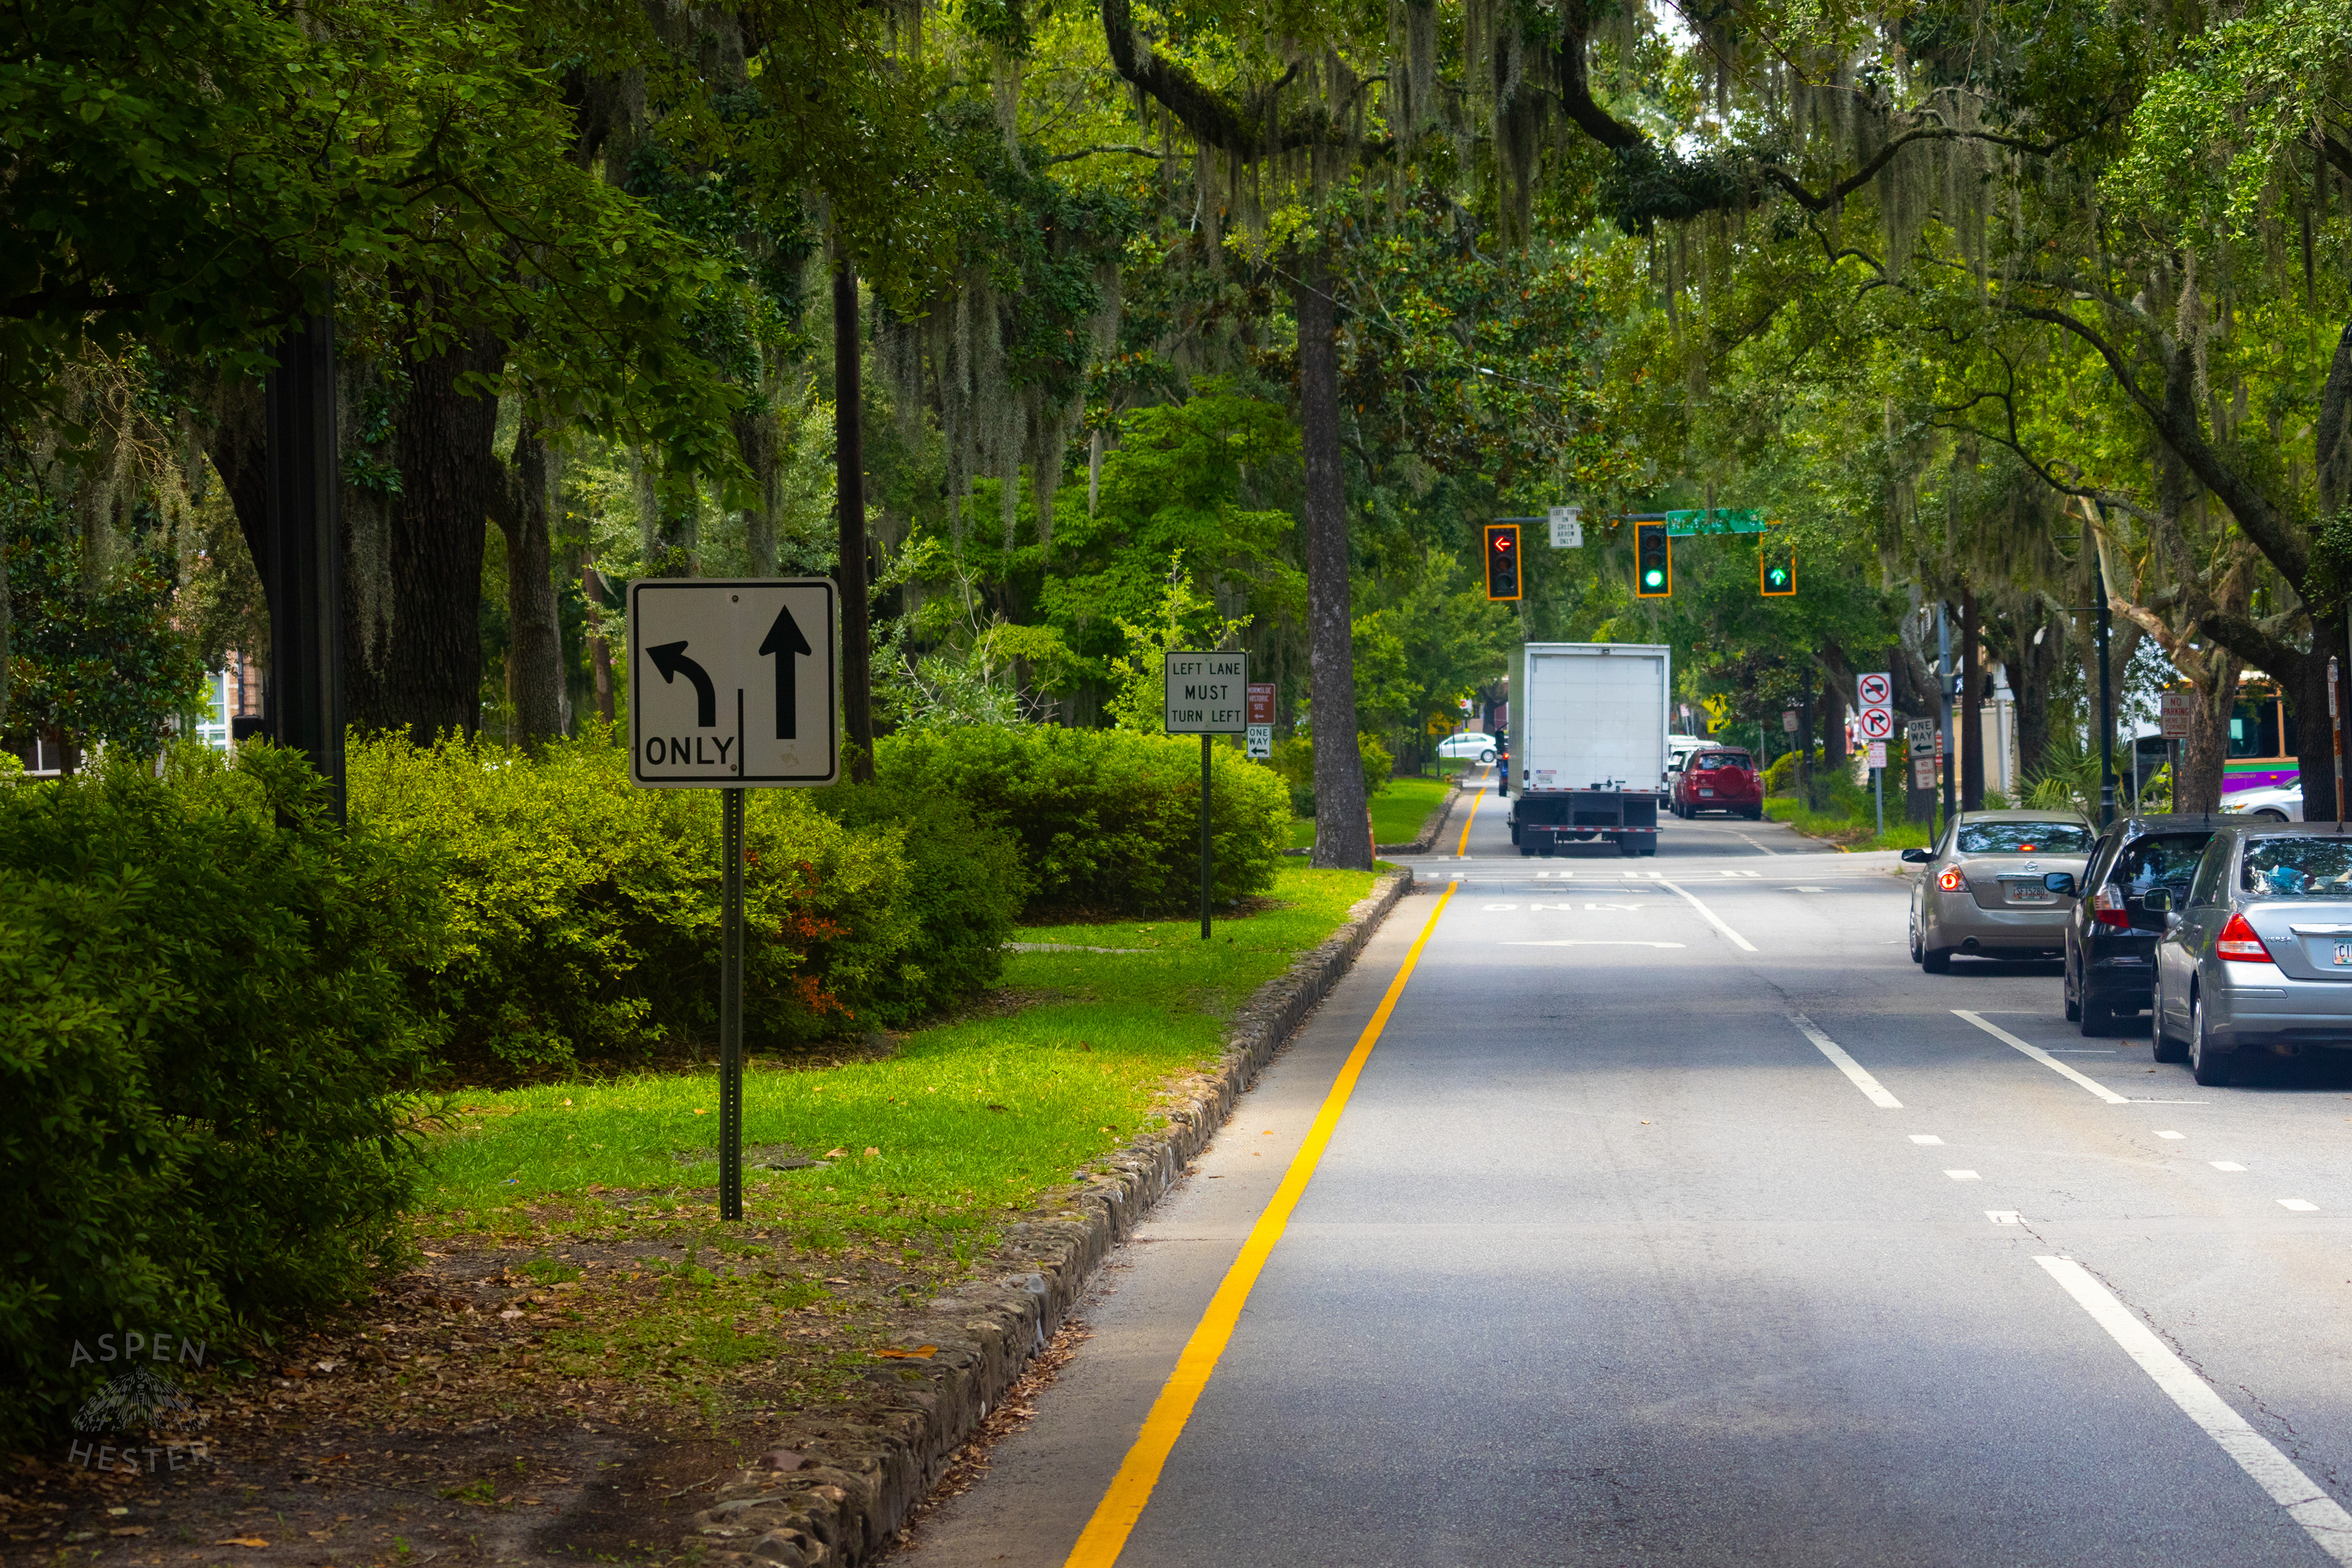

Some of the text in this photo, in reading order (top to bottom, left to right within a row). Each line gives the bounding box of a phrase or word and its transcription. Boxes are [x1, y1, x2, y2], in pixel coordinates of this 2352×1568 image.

[1173, 663, 1240, 675] LEFT LANE
[1185, 685, 1228, 700] MUST
[2170, 698, 2182, 706] NO
[1172, 710, 1241, 722] TURN LEFT
[2163, 707, 2189, 716] PARKING
[1911, 721, 1931, 731] ONE
[1911, 731, 1933, 742] WAY
[646, 736, 734, 765] ONLY
[2339, 945, 2352, 957] CI
